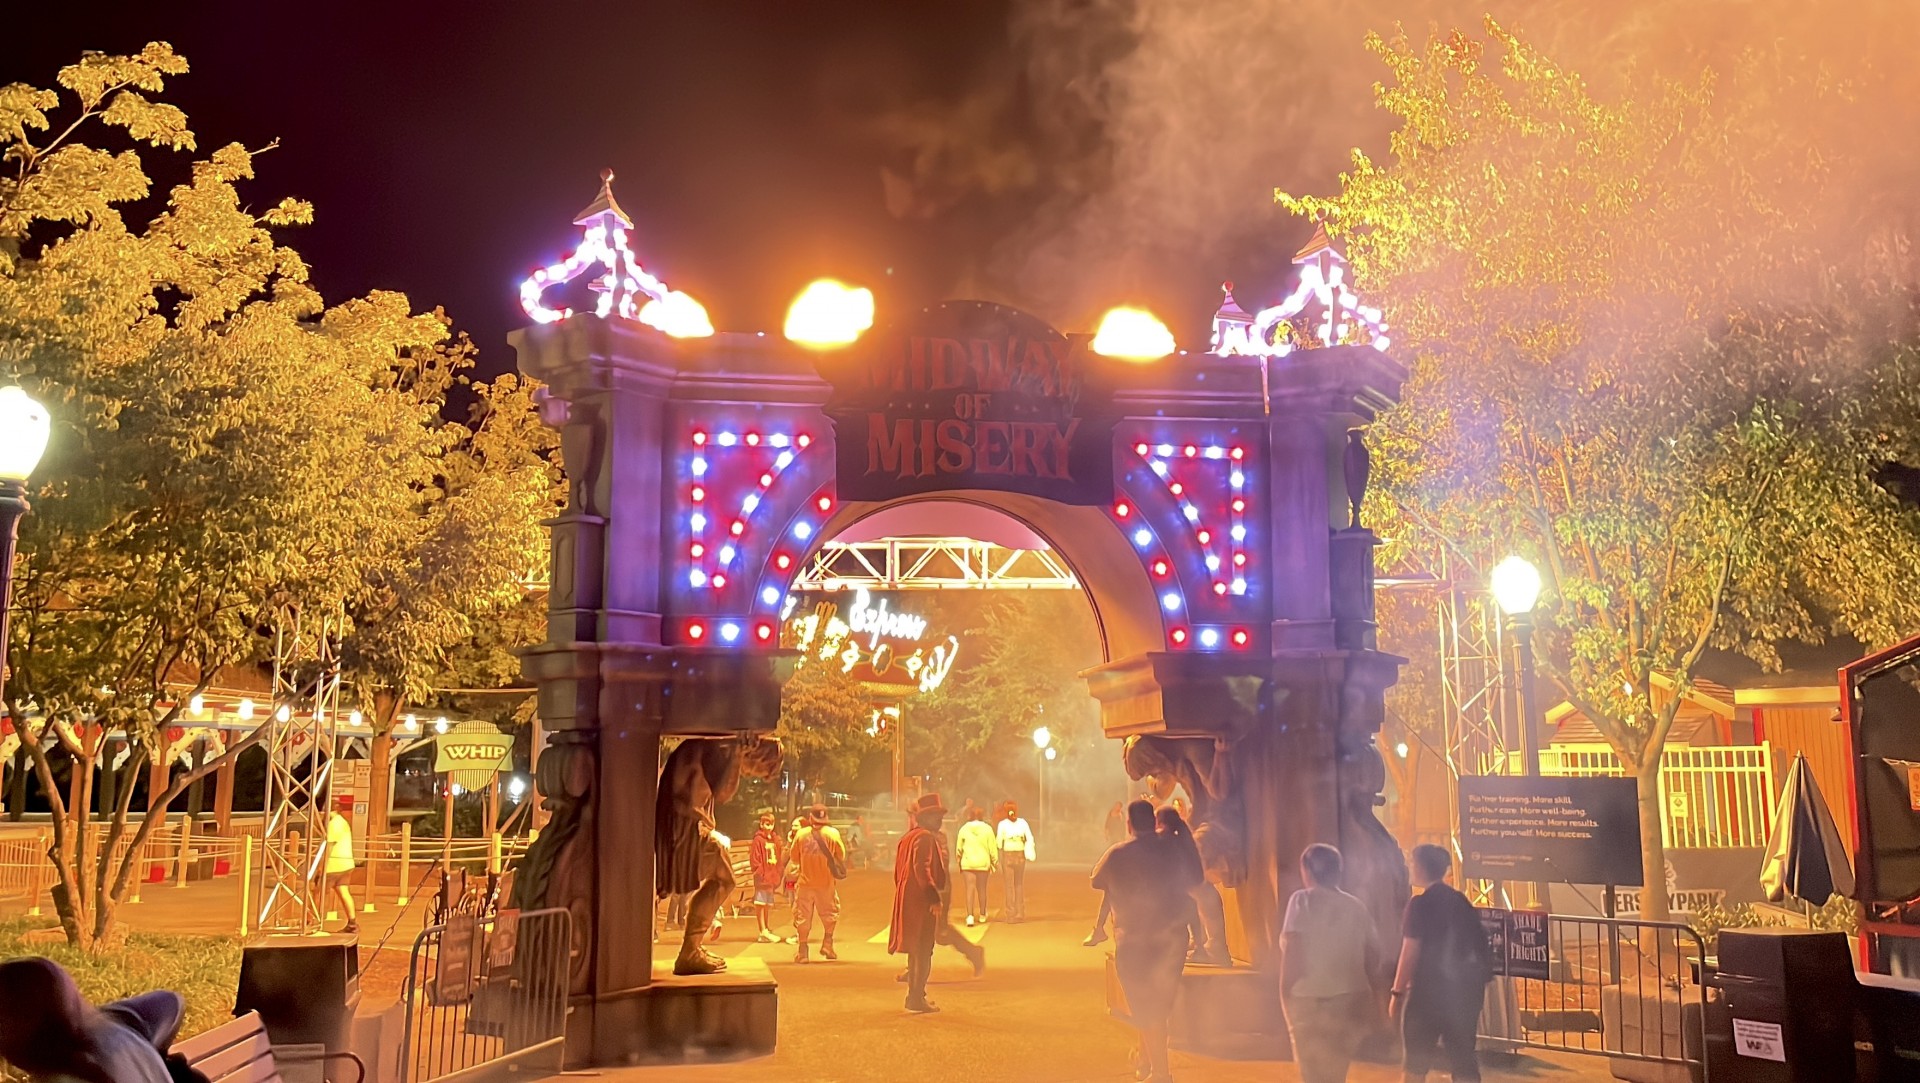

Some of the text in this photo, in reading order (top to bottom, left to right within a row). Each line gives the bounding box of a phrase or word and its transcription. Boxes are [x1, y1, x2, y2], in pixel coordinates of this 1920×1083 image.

[861, 336, 1080, 395] MIDWAY
[953, 393, 992, 419] OF
[864, 412, 1082, 482] MISERY
[444, 744, 507, 760] WHIP
[1532, 796, 1553, 804] More
[1520, 806, 1541, 814] More
[1470, 817, 1498, 825] Further
[1547, 818, 1568, 827] More
[1569, 819, 1599, 827] results.
[1470, 828, 1499, 836] Further
[1535, 829, 1557, 838] More
[1521, 932, 1536, 945] THE
[1510, 942, 1547, 962] FRIGHTS
